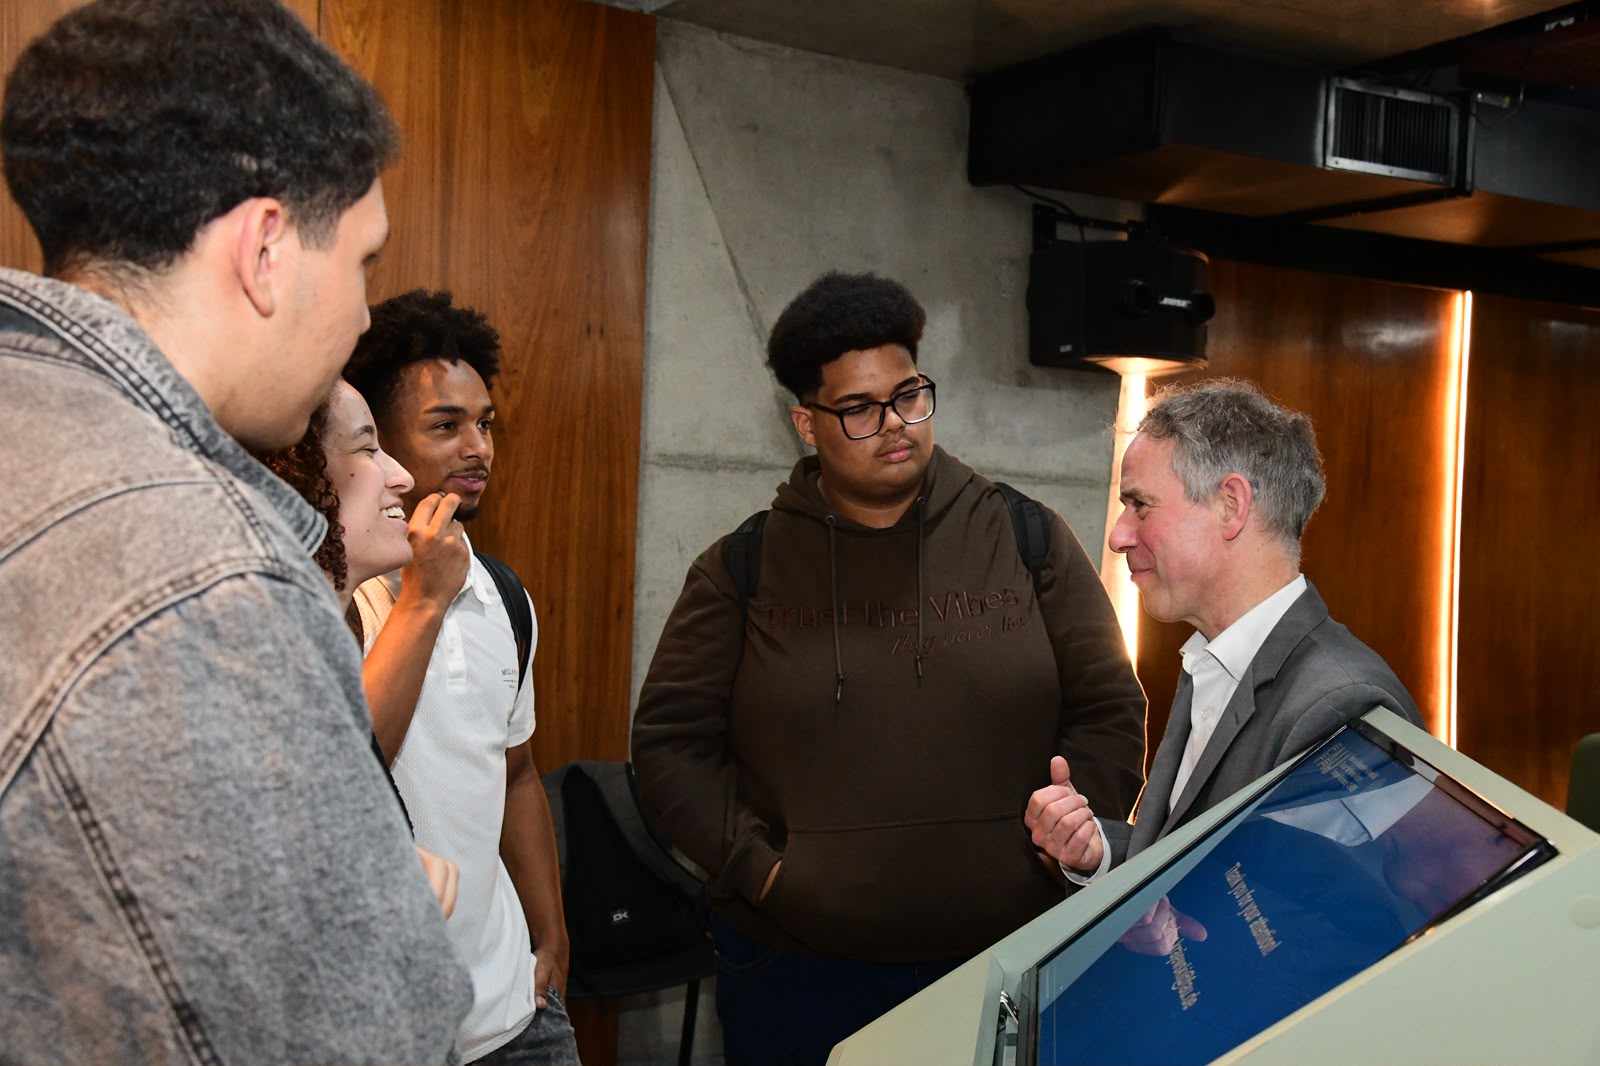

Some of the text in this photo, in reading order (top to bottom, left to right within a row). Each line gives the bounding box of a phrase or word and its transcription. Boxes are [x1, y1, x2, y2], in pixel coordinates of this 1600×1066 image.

[928, 588, 1018, 623] Vibes
[1224, 861, 1246, 888] Thank
[1227, 880, 1249, 900] you
[1237, 888, 1255, 908] for
[1236, 901, 1261, 923] your
